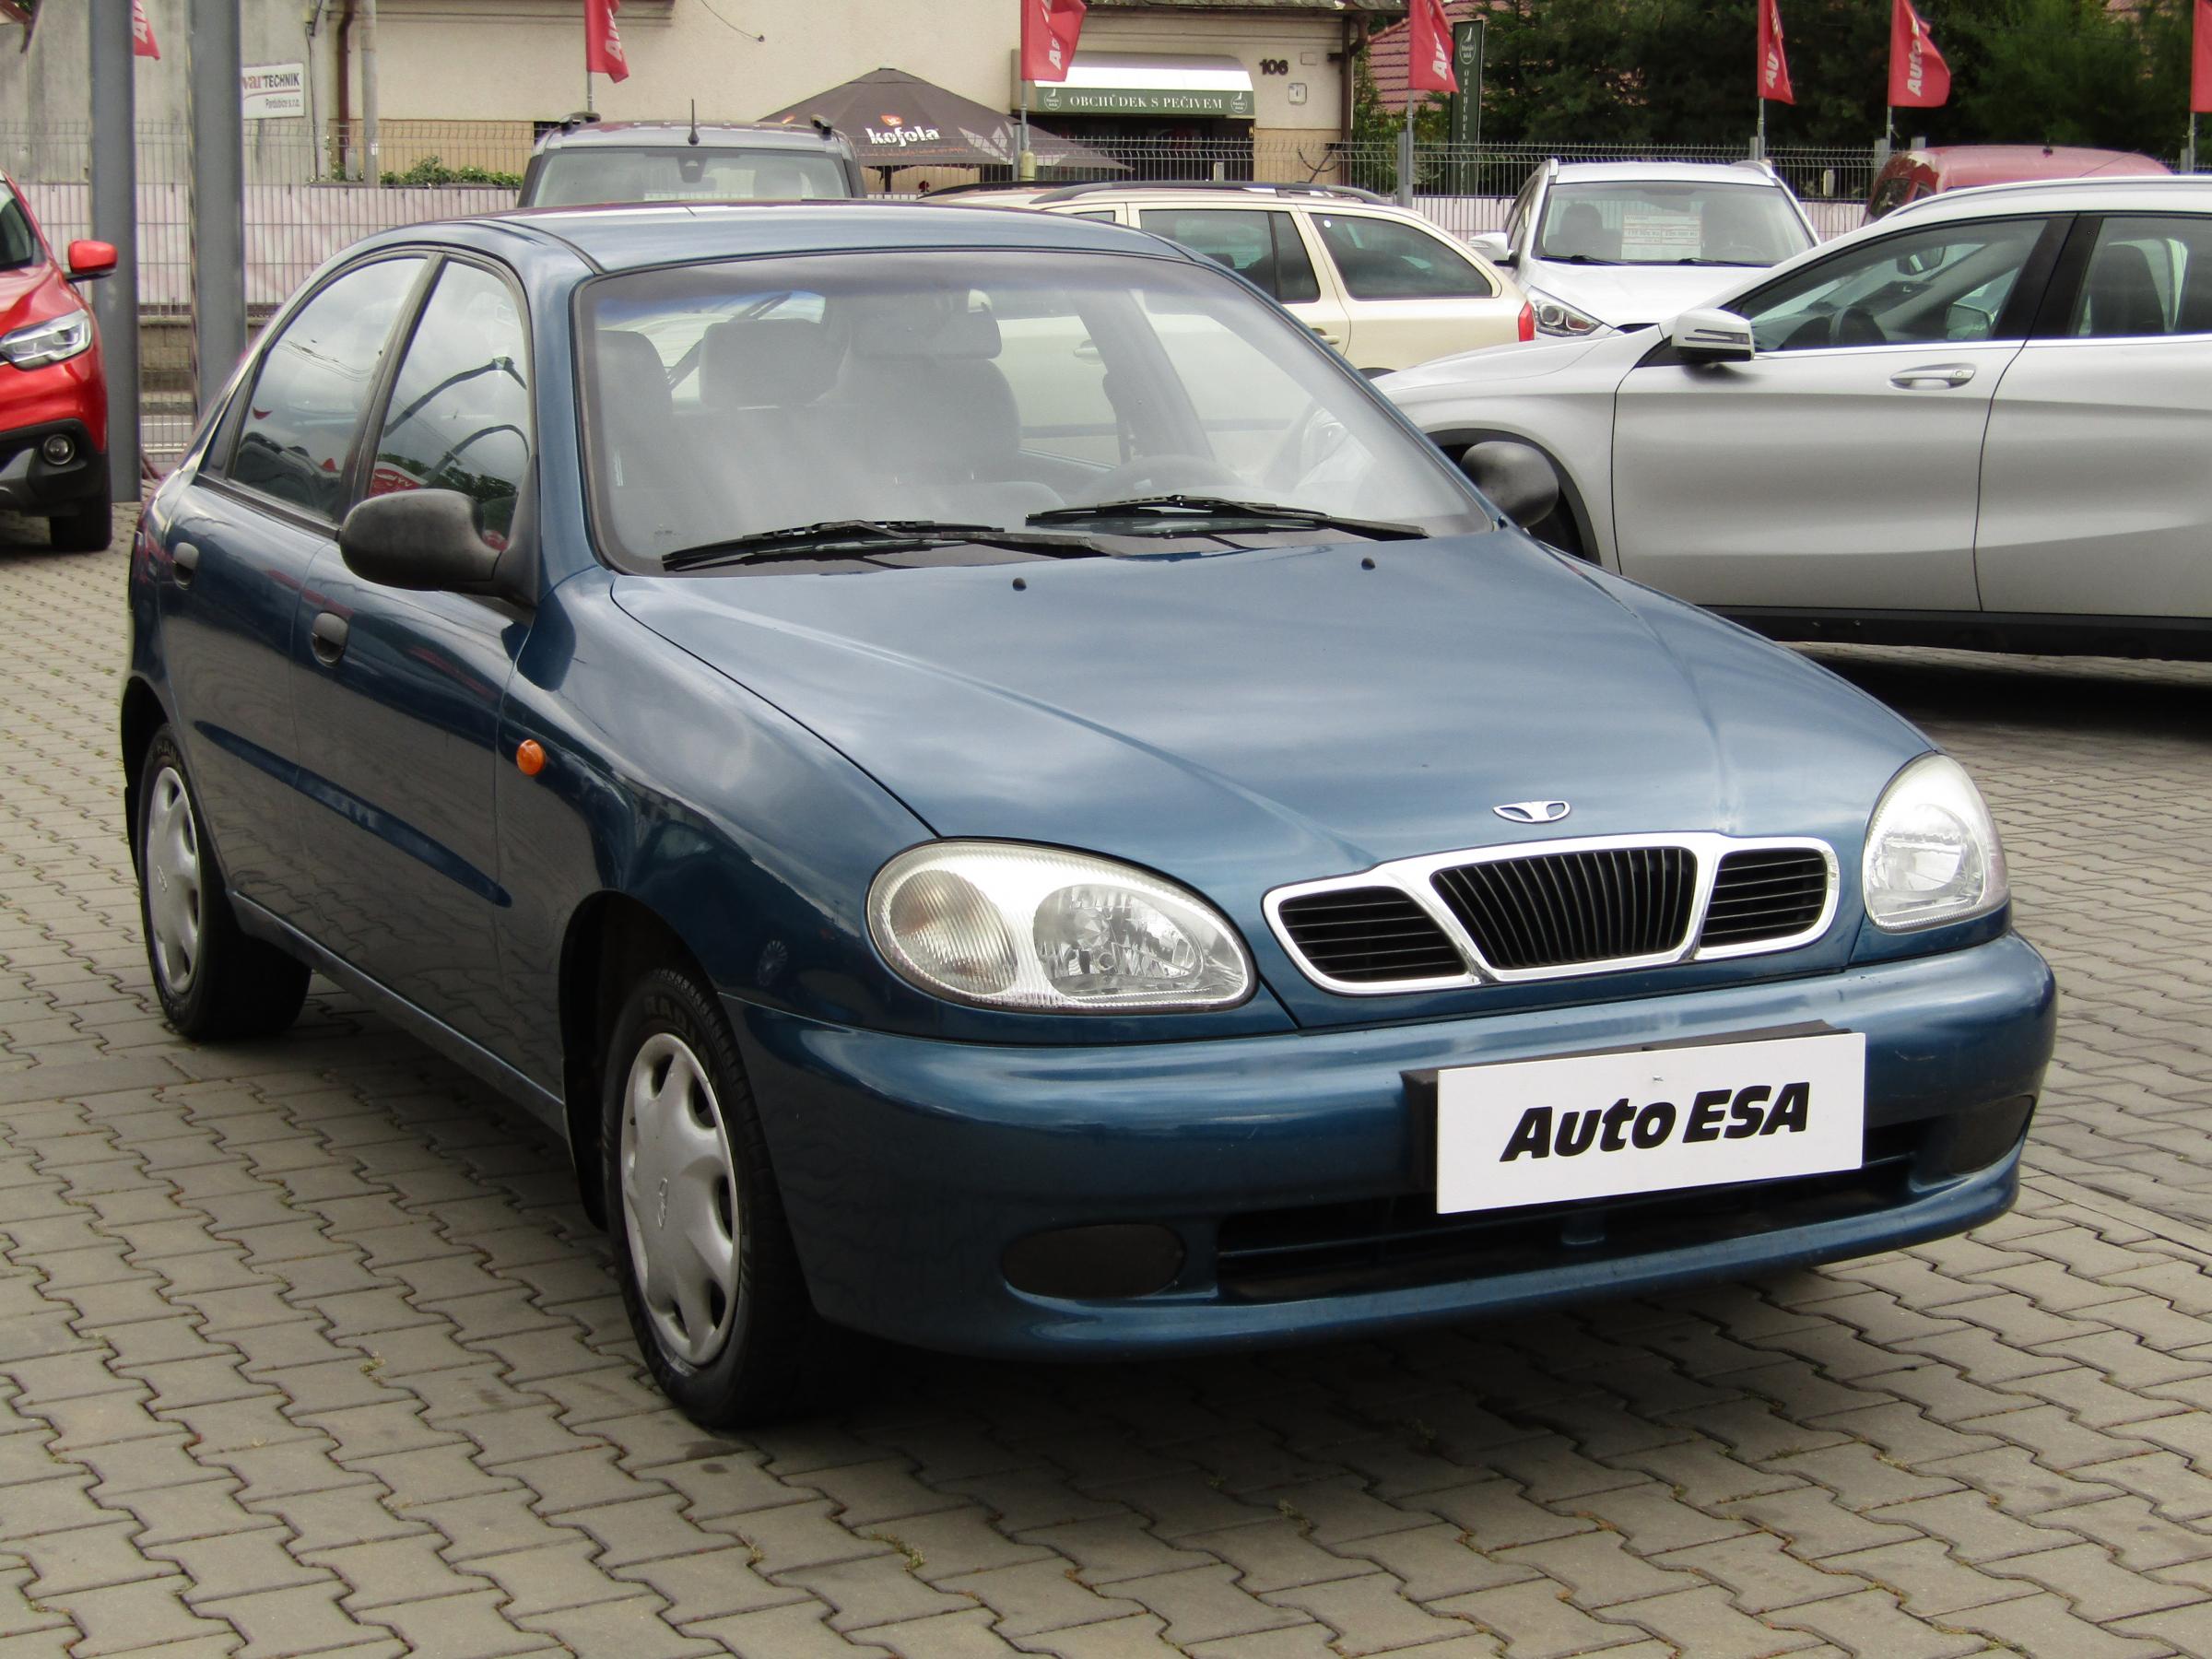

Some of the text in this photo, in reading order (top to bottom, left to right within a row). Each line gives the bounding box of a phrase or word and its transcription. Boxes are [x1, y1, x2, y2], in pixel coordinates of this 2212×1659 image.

[1259, 59, 1288, 75] 106
[1069, 94, 1147, 108] OBCHŮDEK
[1151, 97, 1159, 108] S
[1163, 96, 1222, 110] PEČIVEM
[865, 125, 940, 147] kofola
[1499, 1082, 1810, 1162] Auto ESA
